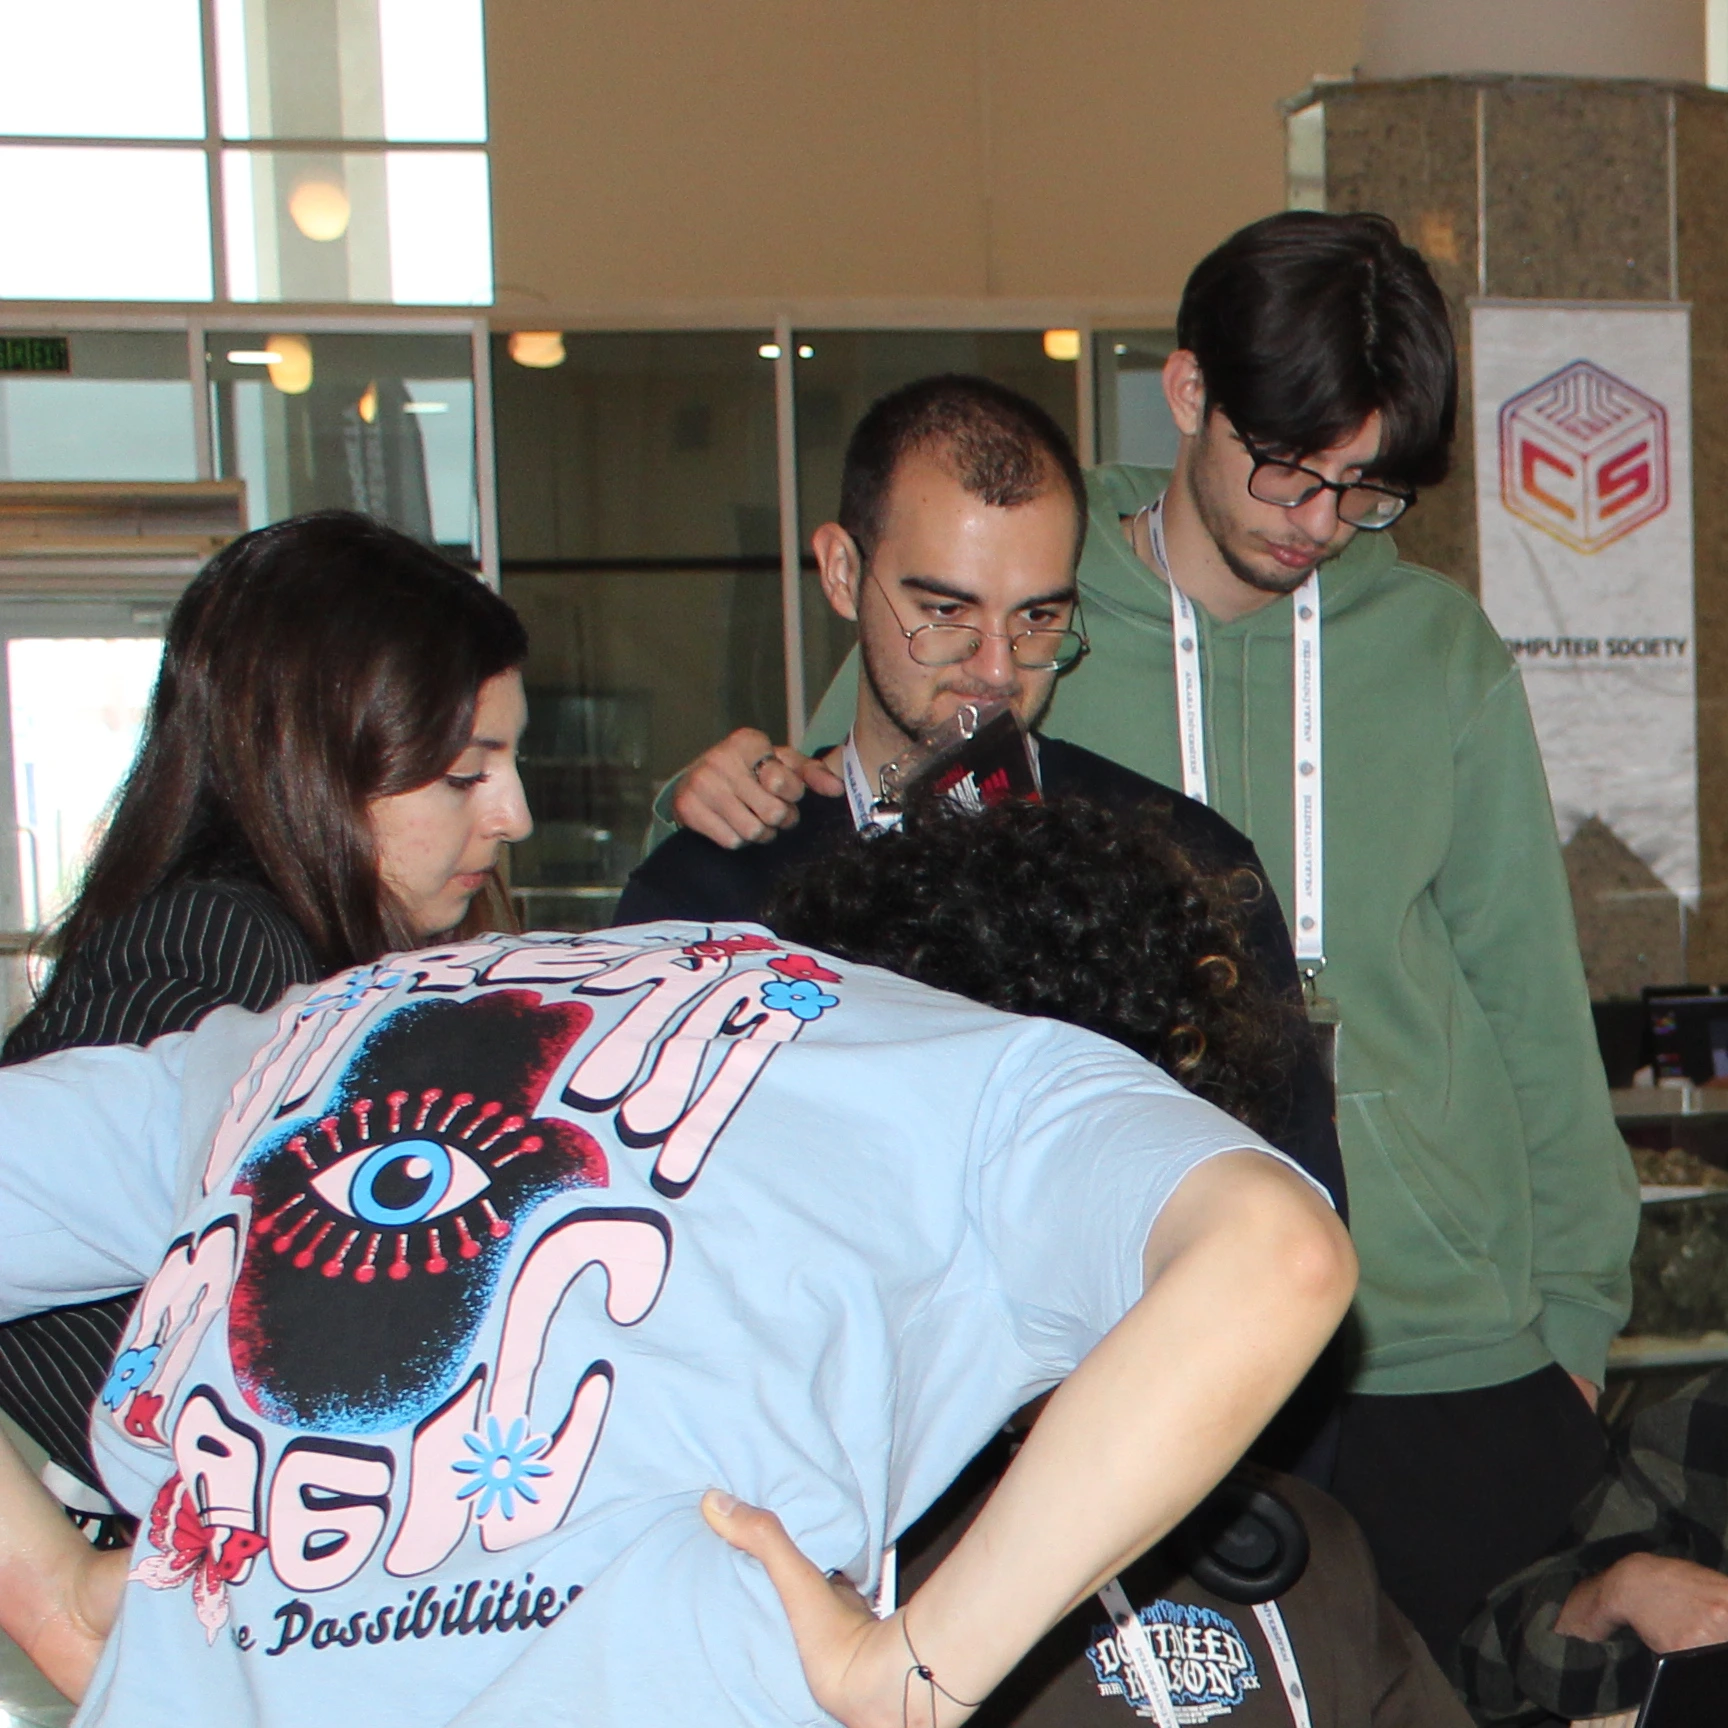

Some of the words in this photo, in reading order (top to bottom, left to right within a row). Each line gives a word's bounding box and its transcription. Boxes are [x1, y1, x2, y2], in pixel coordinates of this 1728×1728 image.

[1504, 637, 1599, 657] OMPUTER
[1606, 637, 1687, 657] SOCIETY
[1302, 704, 1312, 743] ANKARA
[1303, 858, 1313, 898] ANKARA
[1241, 1675, 1261, 1689] XX
